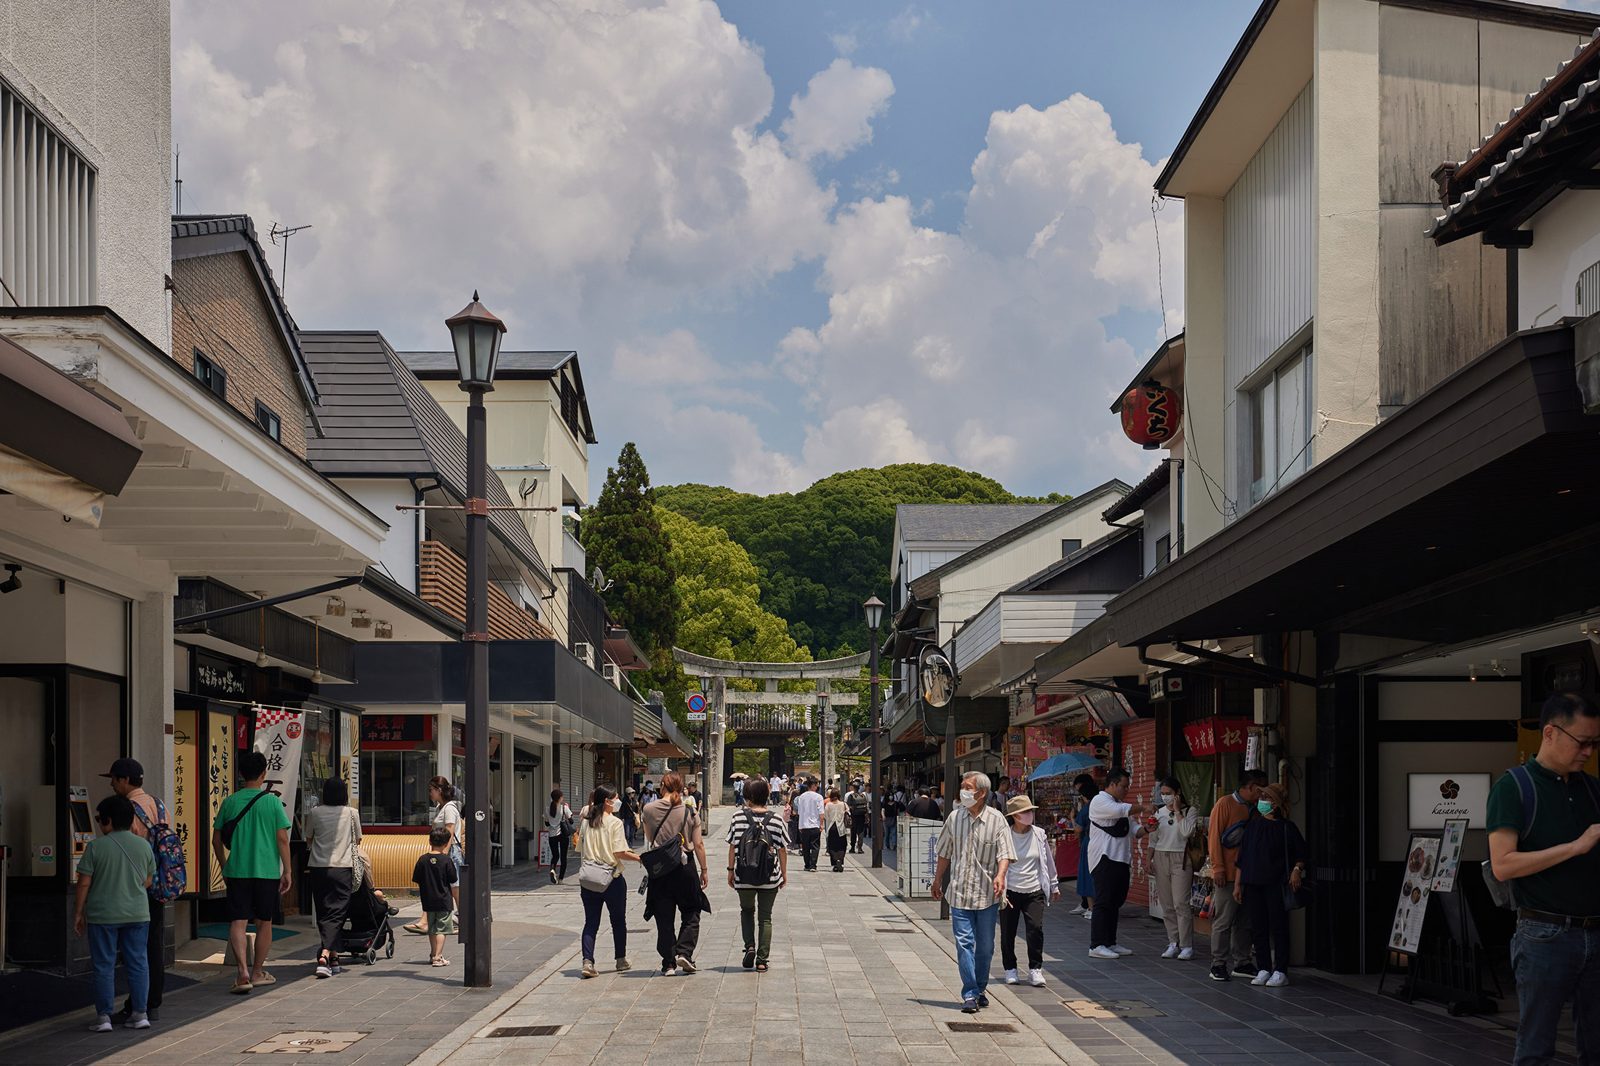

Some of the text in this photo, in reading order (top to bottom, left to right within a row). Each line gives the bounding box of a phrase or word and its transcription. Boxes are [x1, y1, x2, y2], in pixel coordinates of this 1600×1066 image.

[368, 730, 402, 741] 中村屋
[1220, 727, 1243, 747] 松
[174, 754, 184, 816] 手作り箸工房
[1431, 803, 1470, 819] kasanoya
